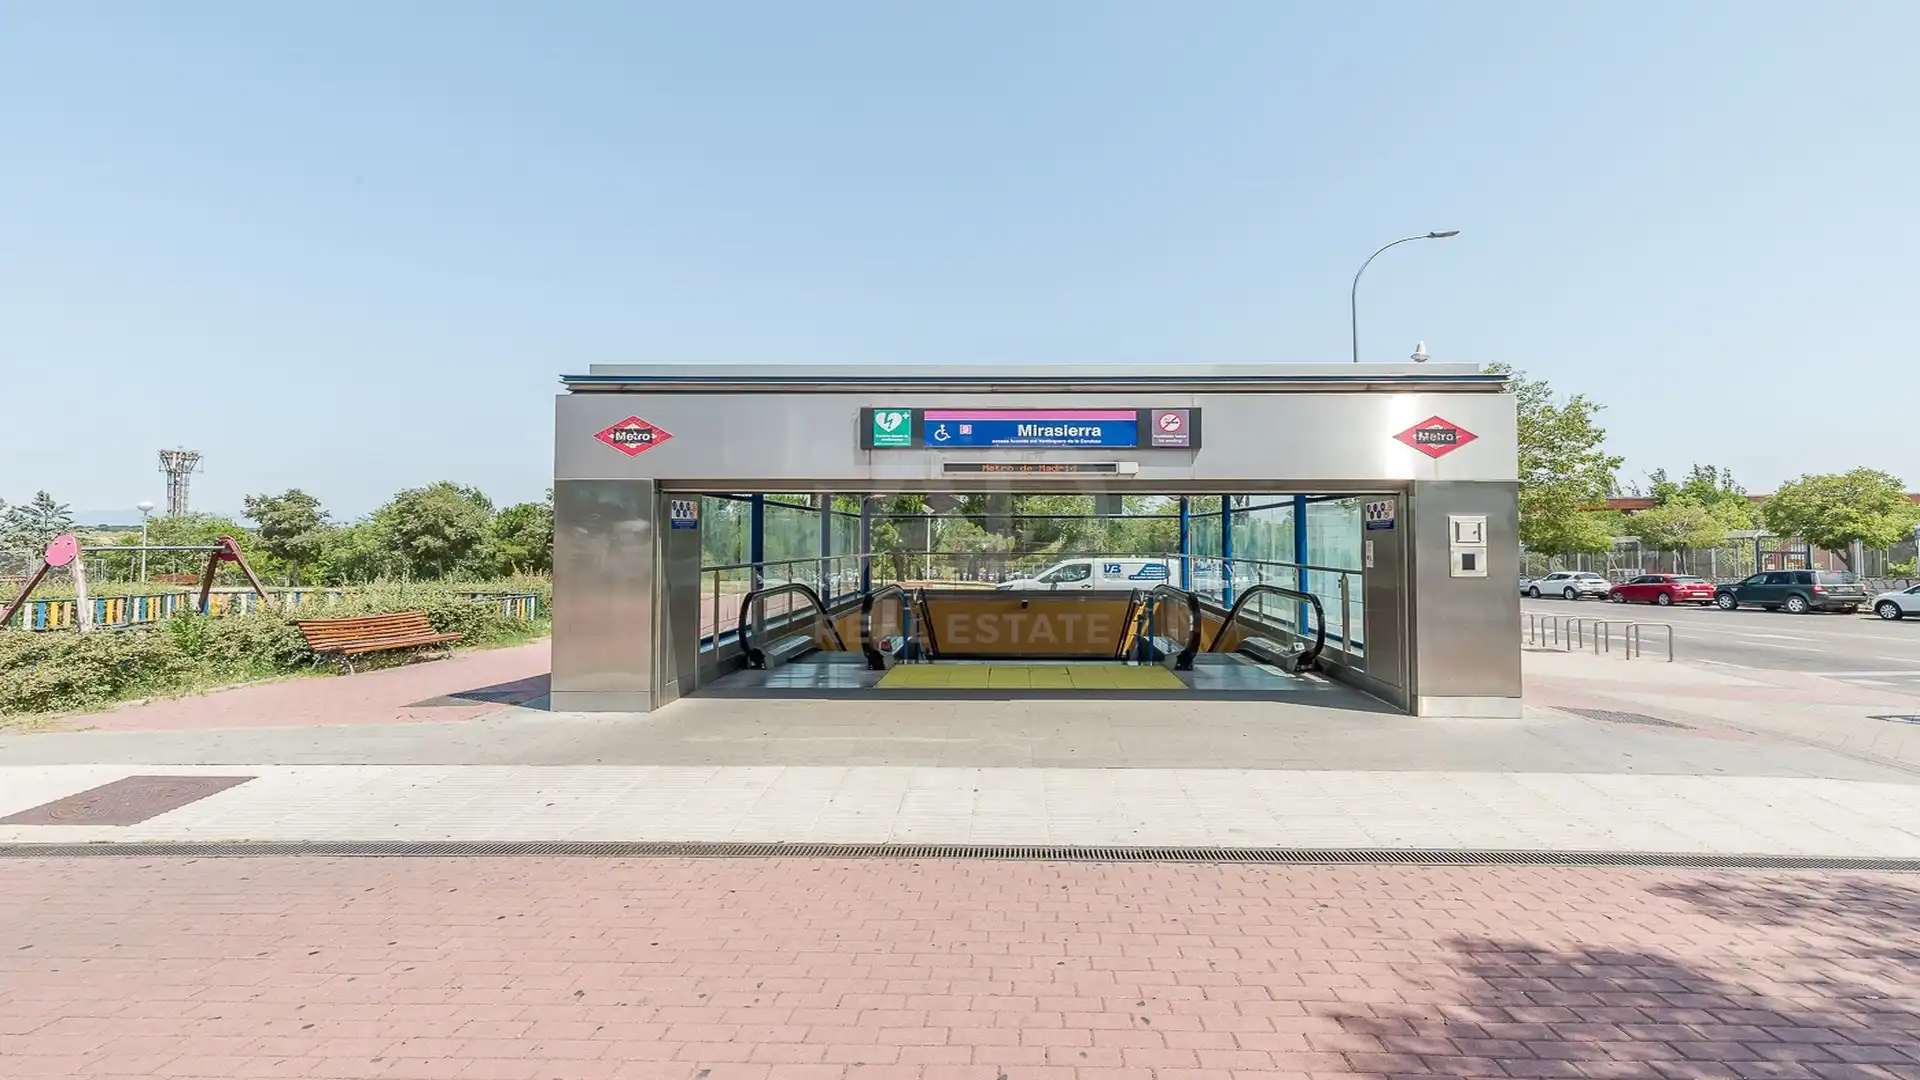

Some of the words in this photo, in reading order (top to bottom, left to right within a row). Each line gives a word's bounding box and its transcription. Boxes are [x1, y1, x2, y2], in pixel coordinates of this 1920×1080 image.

[615, 430, 651, 441] Metro
[1017, 424, 1102, 437] Mirasierra
[1418, 431, 1455, 441] Metro
